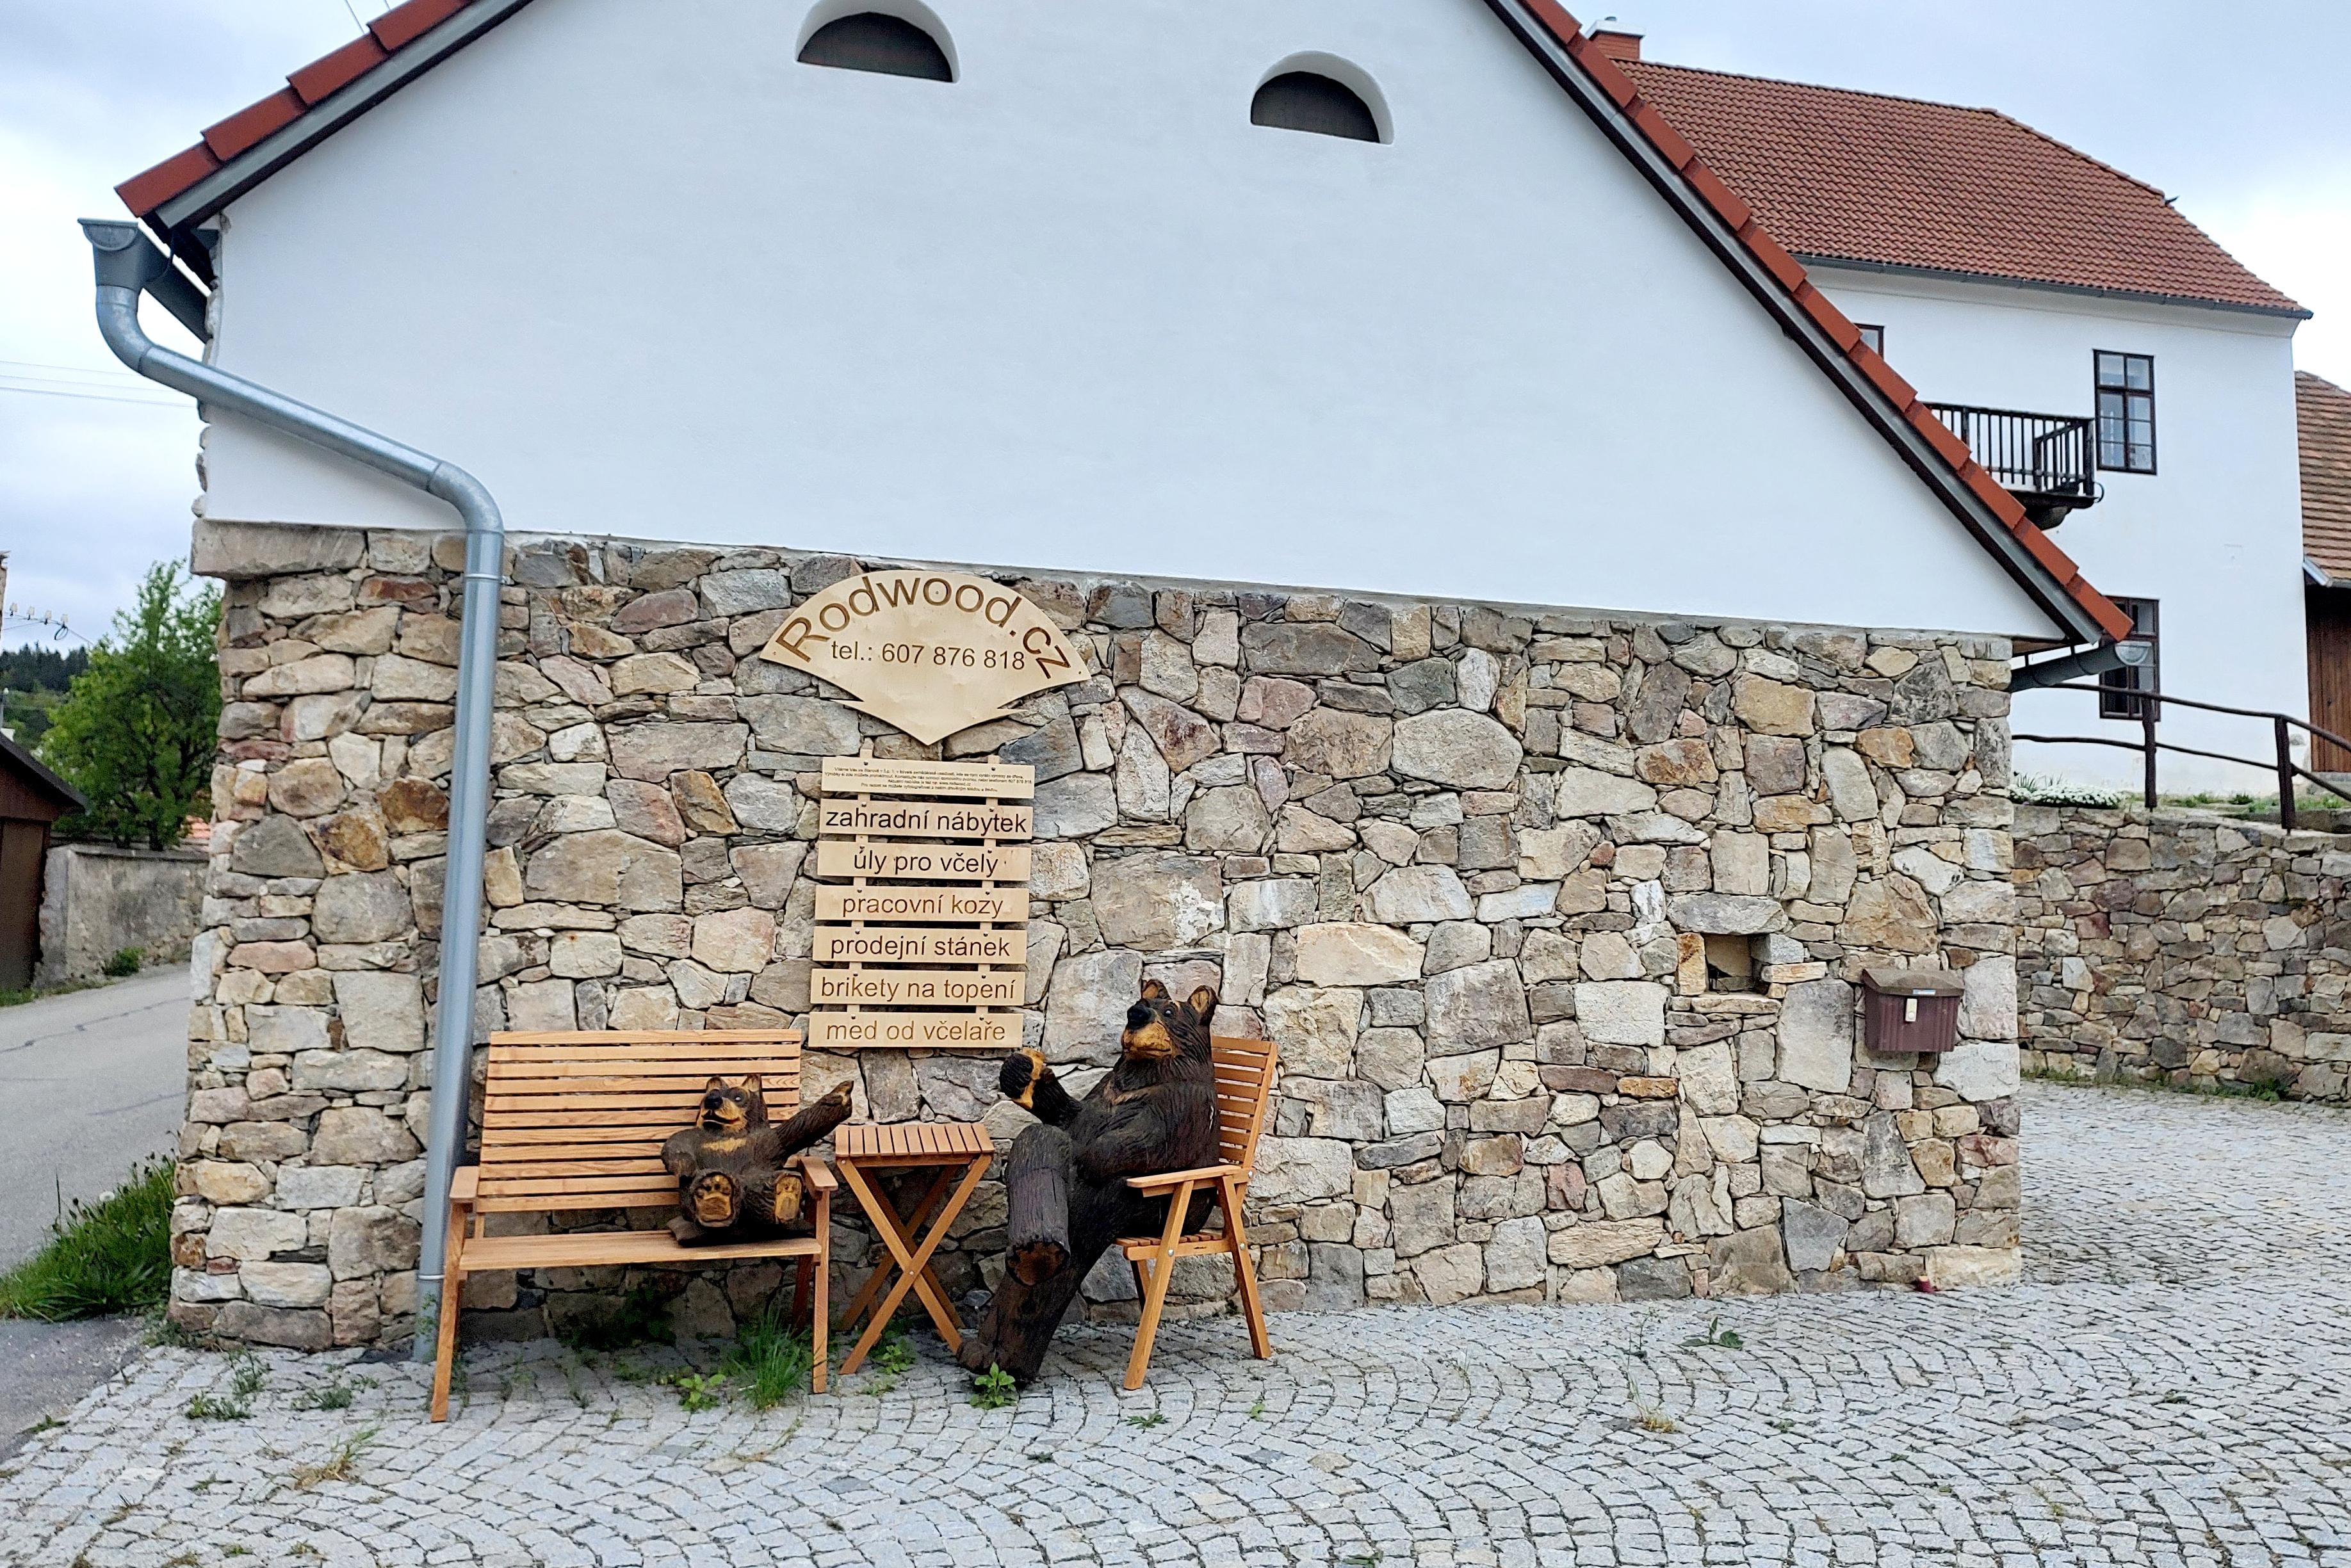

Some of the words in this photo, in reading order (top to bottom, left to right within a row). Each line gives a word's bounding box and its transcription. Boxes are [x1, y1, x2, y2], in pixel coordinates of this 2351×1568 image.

[776, 576, 1071, 679] Rodwood.cz
[832, 642, 872, 661] tel.:
[881, 643, 925, 664] 607
[933, 646, 975, 667] 876
[984, 649, 1025, 670] 818
[826, 807, 929, 830] zahradní
[937, 812, 1027, 836] nábytek
[854, 848, 887, 875] úly
[895, 855, 932, 875] pro
[940, 853, 999, 878] včely
[842, 895, 943, 917] pracovní
[952, 895, 1004, 918] kozy
[831, 935, 927, 960] prodejní
[934, 936, 1011, 957] stánek
[821, 976, 900, 1002] brikety
[907, 983, 935, 998] na
[943, 980, 1016, 1003] topení
[827, 1021, 877, 1040] med
[886, 1021, 915, 1040] od
[923, 1019, 1005, 1041] včelaře
